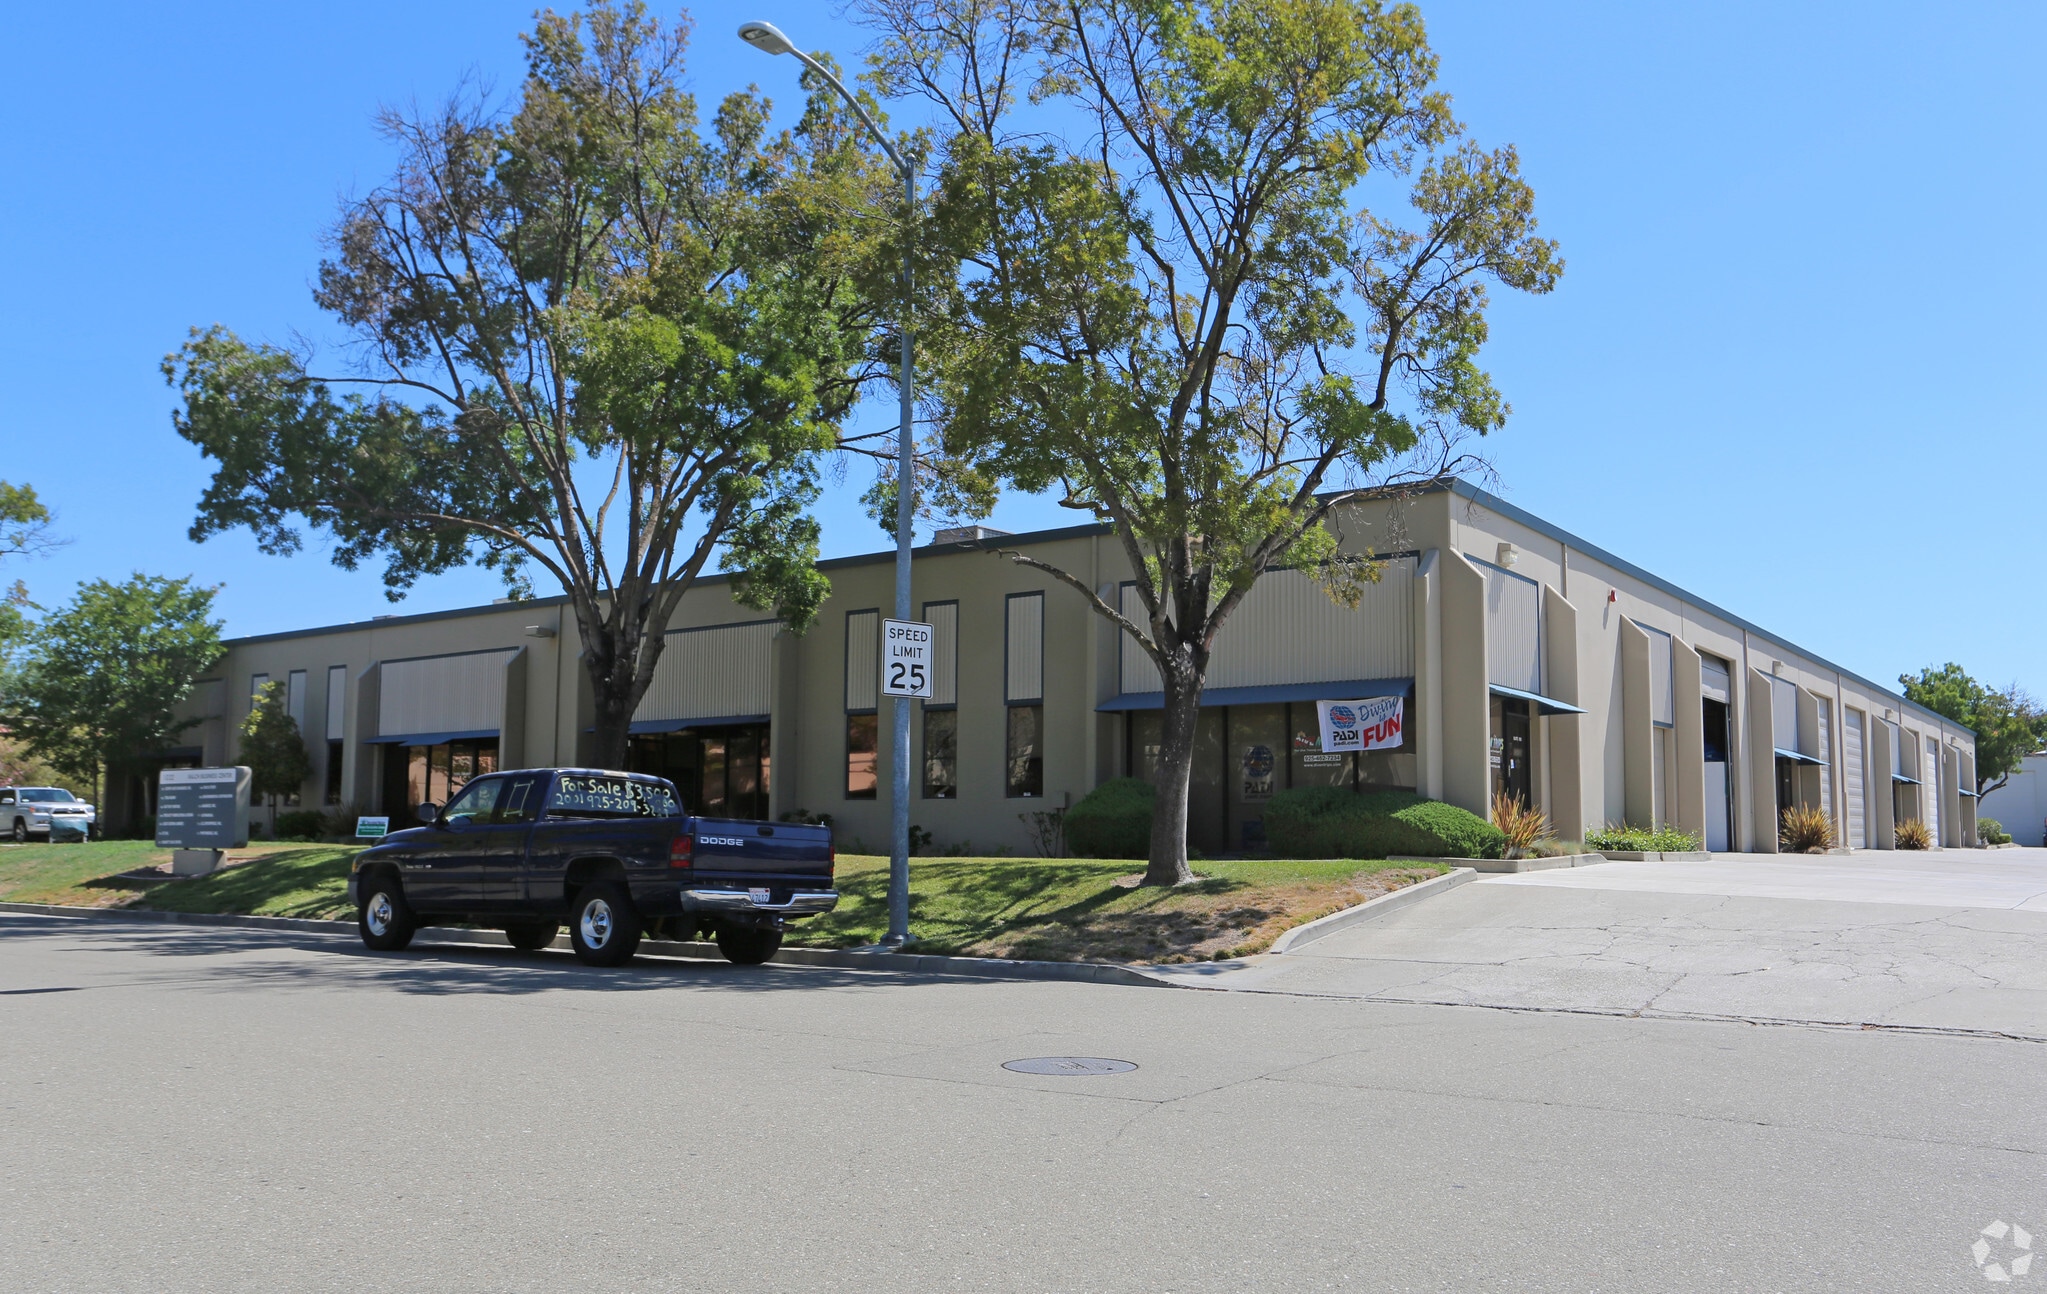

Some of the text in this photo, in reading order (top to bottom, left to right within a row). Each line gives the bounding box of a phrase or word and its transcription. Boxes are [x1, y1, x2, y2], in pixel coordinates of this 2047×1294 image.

[889, 628, 928, 642] SPEED
[893, 645, 923, 658] LIMIT
[890, 662, 925, 690] 25
[1358, 697, 1398, 721] Diving
[1379, 712, 1387, 722] is
[1333, 730, 1359, 741] PADI
[1363, 713, 1400, 748] FUN
[561, 778, 670, 802] For Sale $3,500
[556, 793, 583, 805] 2001
[700, 837, 744, 846] DODGE
